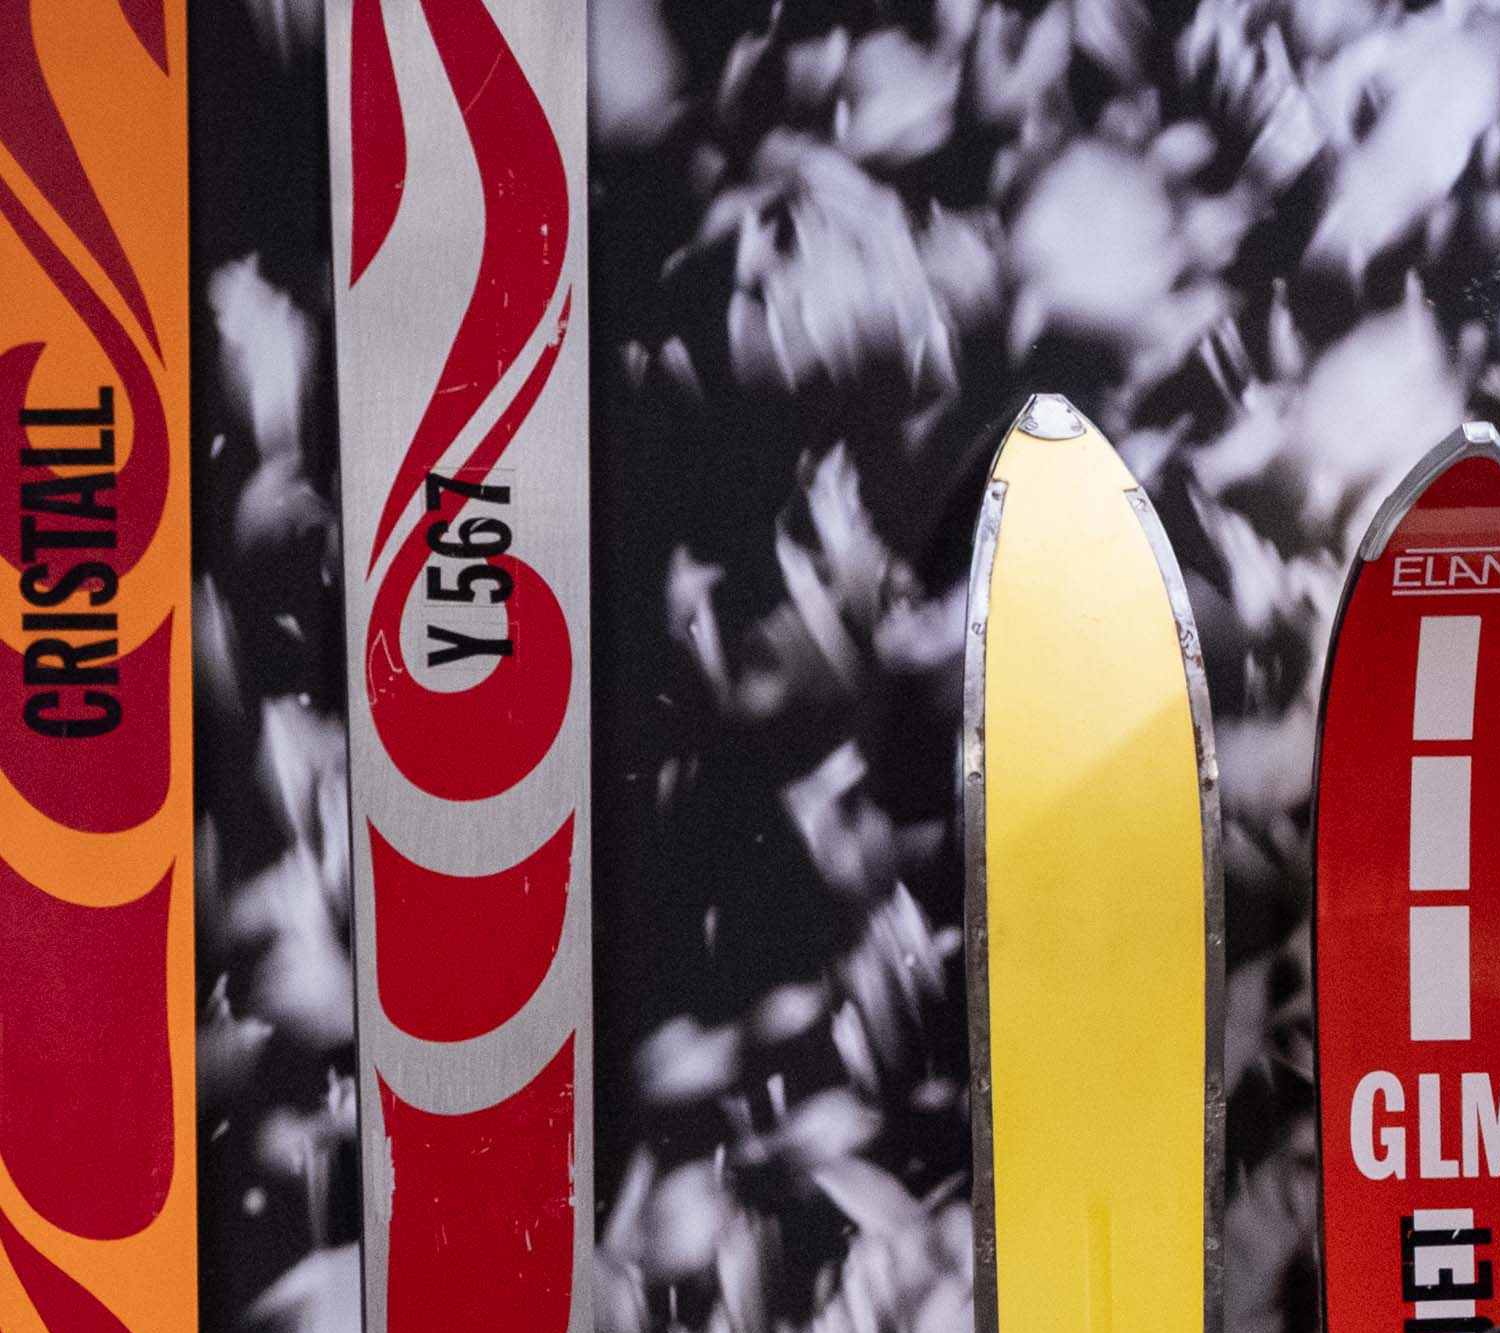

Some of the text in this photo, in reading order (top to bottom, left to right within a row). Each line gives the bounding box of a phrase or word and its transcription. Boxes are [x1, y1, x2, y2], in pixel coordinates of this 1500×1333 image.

[19, 384, 123, 740] CRISTALL
[426, 471, 515, 667] Y 567
